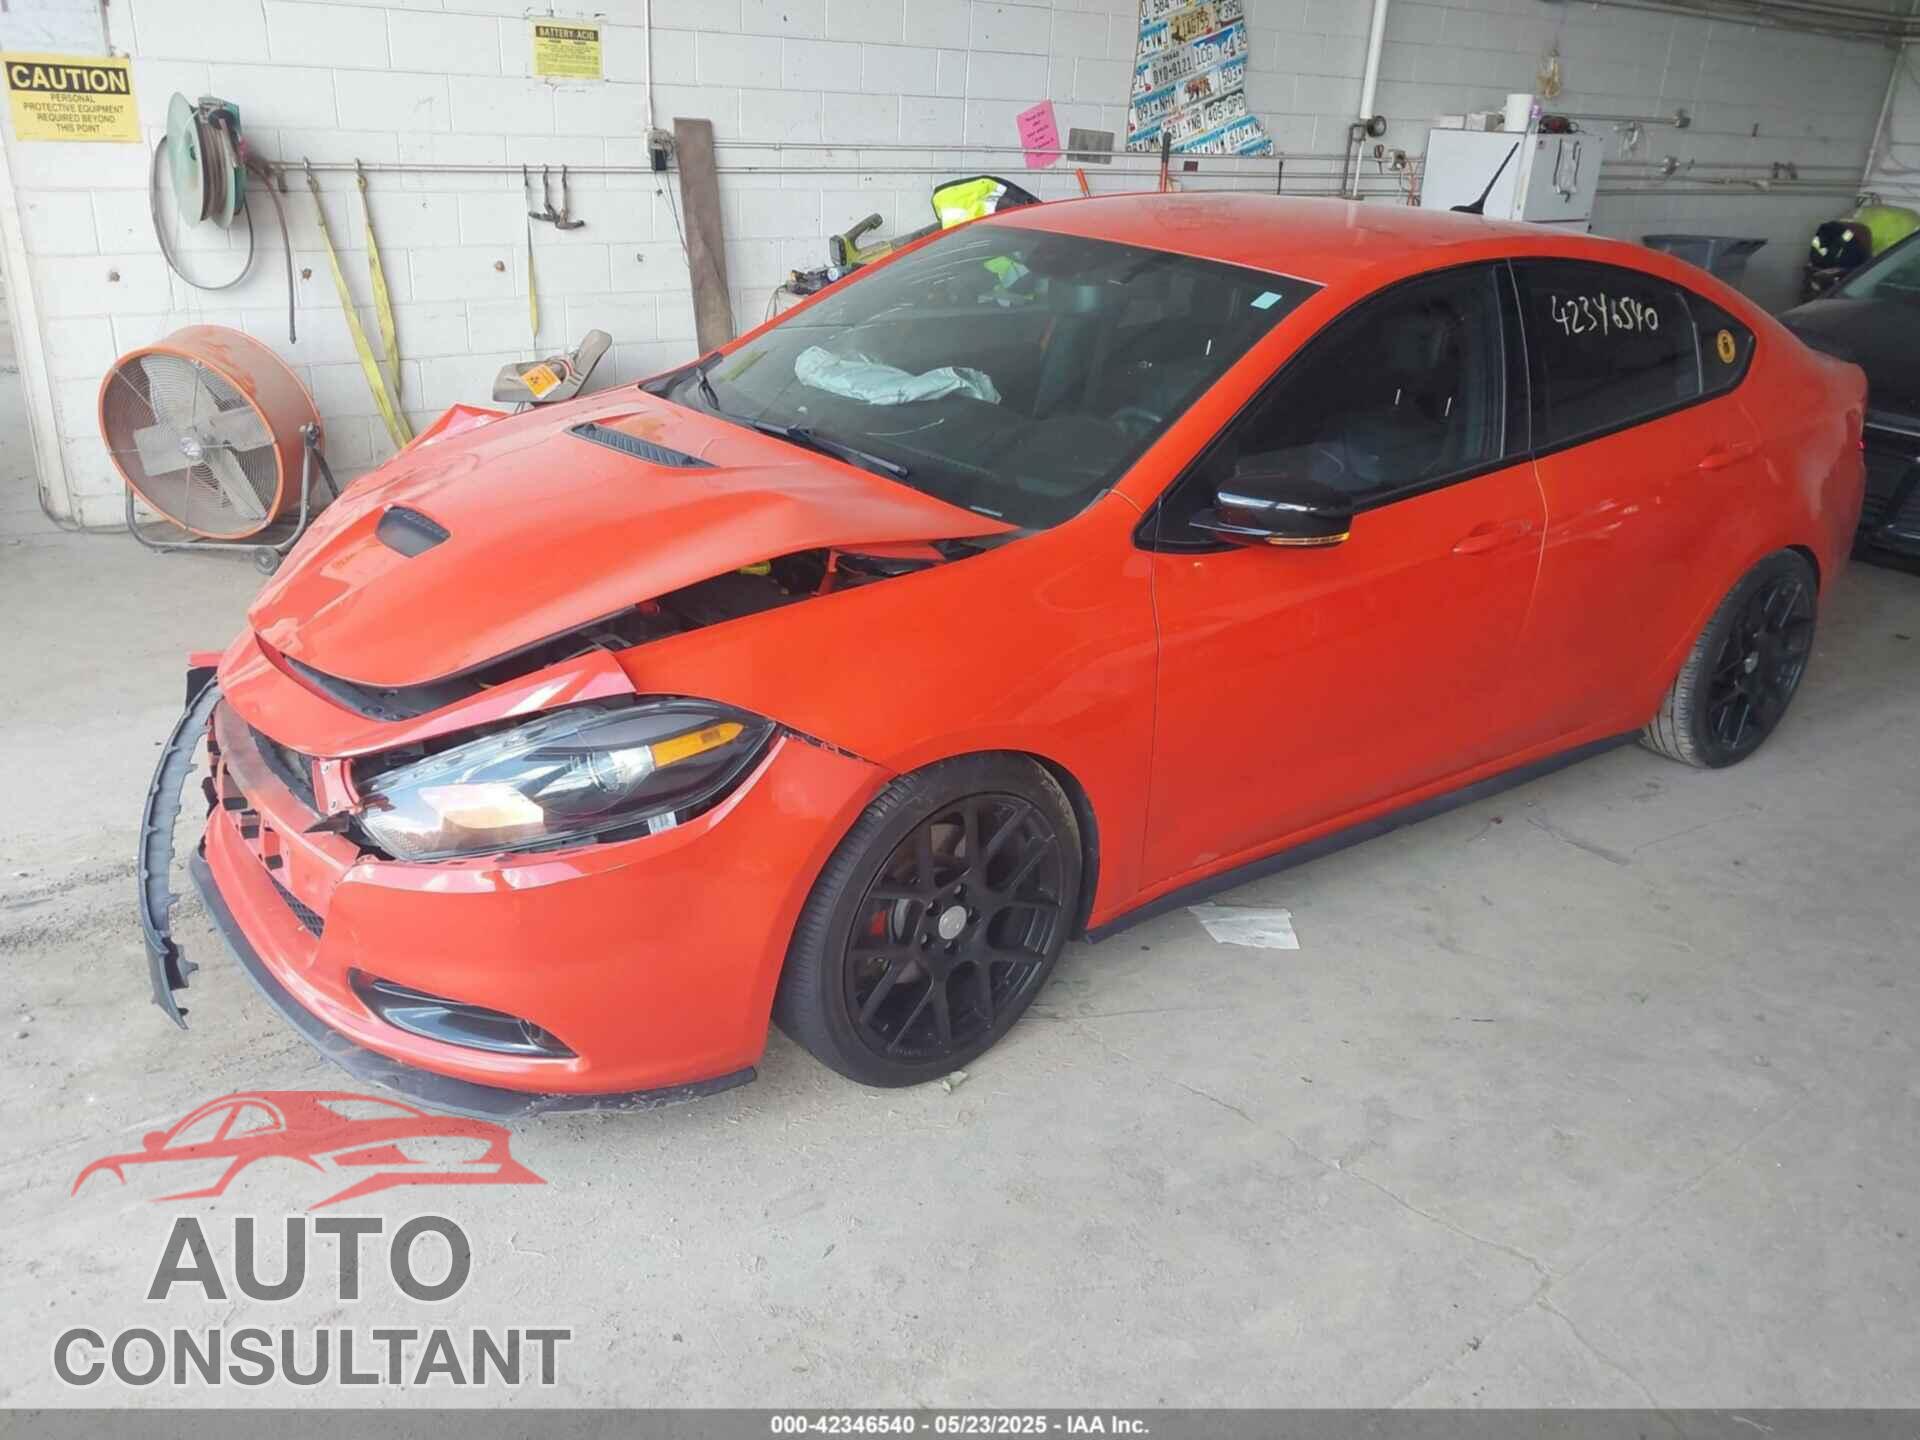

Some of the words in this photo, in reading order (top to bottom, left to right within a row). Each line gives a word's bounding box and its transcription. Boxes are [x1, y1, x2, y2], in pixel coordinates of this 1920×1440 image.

[11, 65, 126, 92] CAUTION
[50, 94, 96, 103] PERSONAL
[23, 102, 76, 112] PROTECTIVE
[78, 104, 124, 113] EQUIPMENT
[37, 113, 80, 122] REQUIRED
[82, 115, 116, 123] BEYOND
[56, 124, 75, 132] THIS
[77, 124, 101, 133] POINT
[1551, 292, 1659, 336] 42346540
